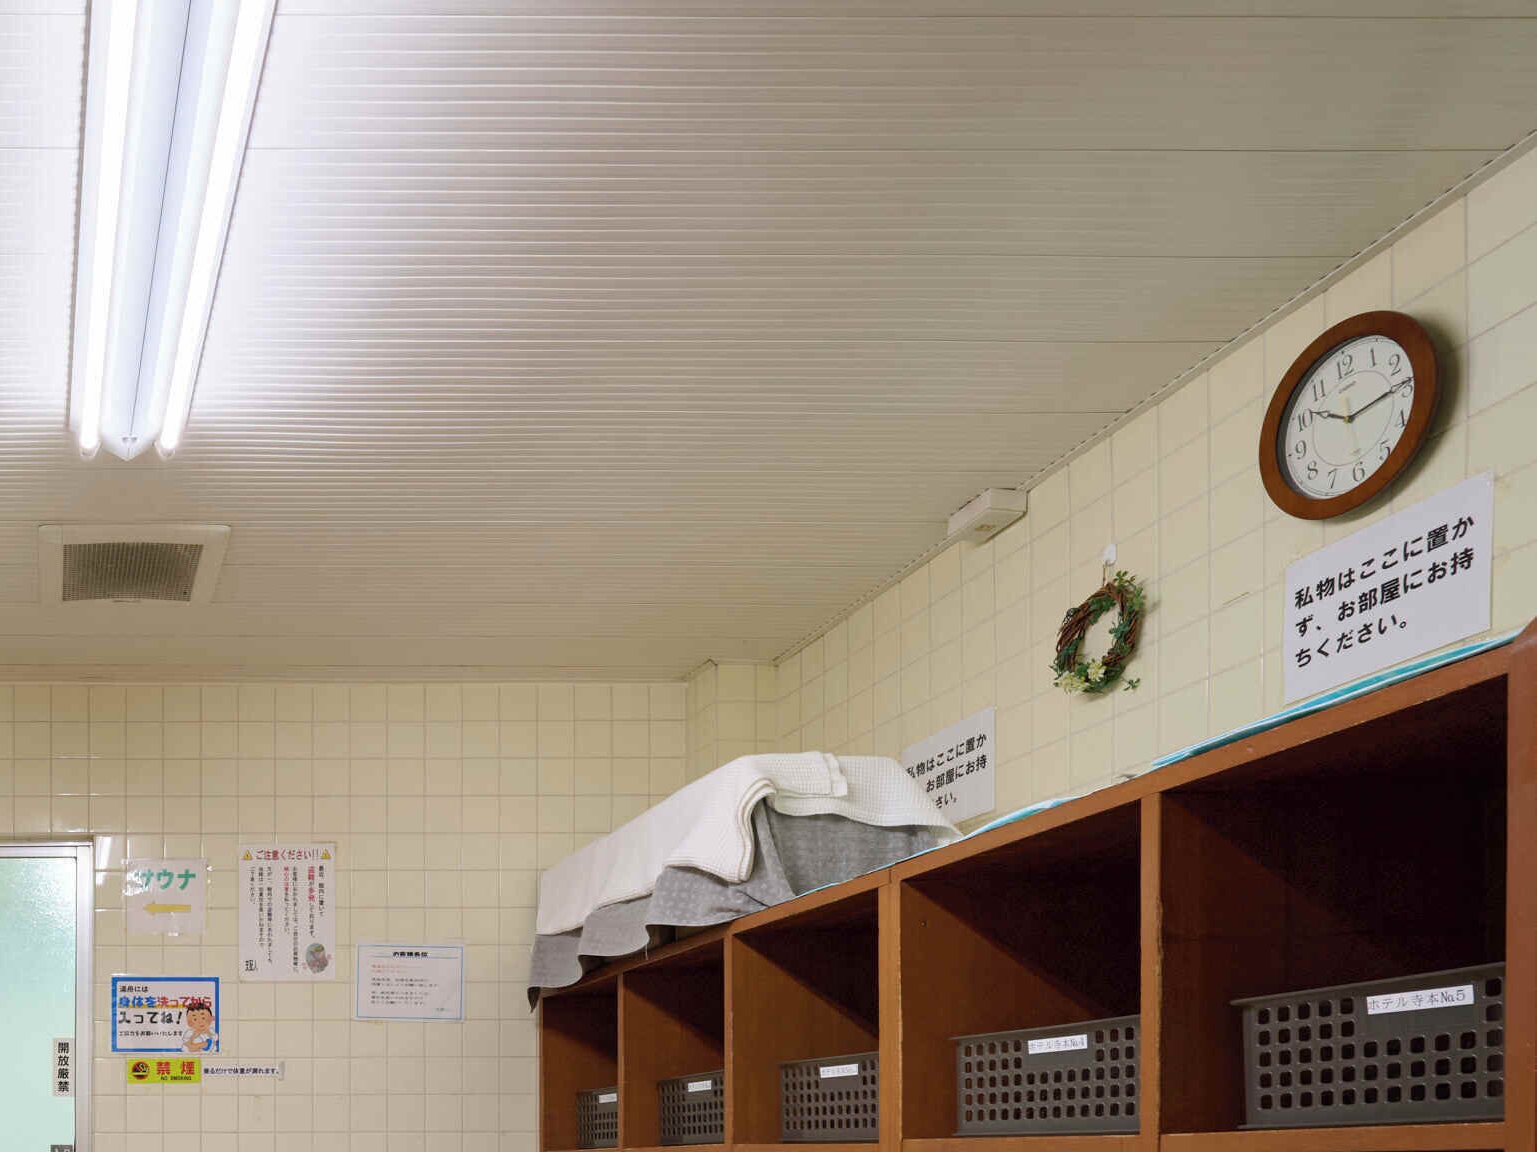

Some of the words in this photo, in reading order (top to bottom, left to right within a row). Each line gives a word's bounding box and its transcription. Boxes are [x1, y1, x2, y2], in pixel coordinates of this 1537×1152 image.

[1336, 354, 1354, 379] 12
[1370, 347, 1377, 367] 1
[1388, 353, 1401, 376] 2
[1312, 379, 1326, 402] 11
[1297, 408, 1312, 432] 10
[1394, 410, 1406, 428] 4
[1295, 440, 1307, 460] 9
[1379, 438, 1391, 460] 5
[1307, 461, 1318, 480] 8
[1328, 468, 1338, 489] 7
[1352, 461, 1365, 481] 6
[1294, 516, 1475, 610] 私物はここに置か
[1295, 547, 1475, 637] ず、お部屋にお持
[1295, 615, 1407, 668] ちください。
[926, 754, 987, 793] お部屋にお持
[935, 793, 957, 809] さい。
[118, 996, 212, 1009] 身体を洗ってから
[57, 1042, 69, 1093] 開放厳禁
